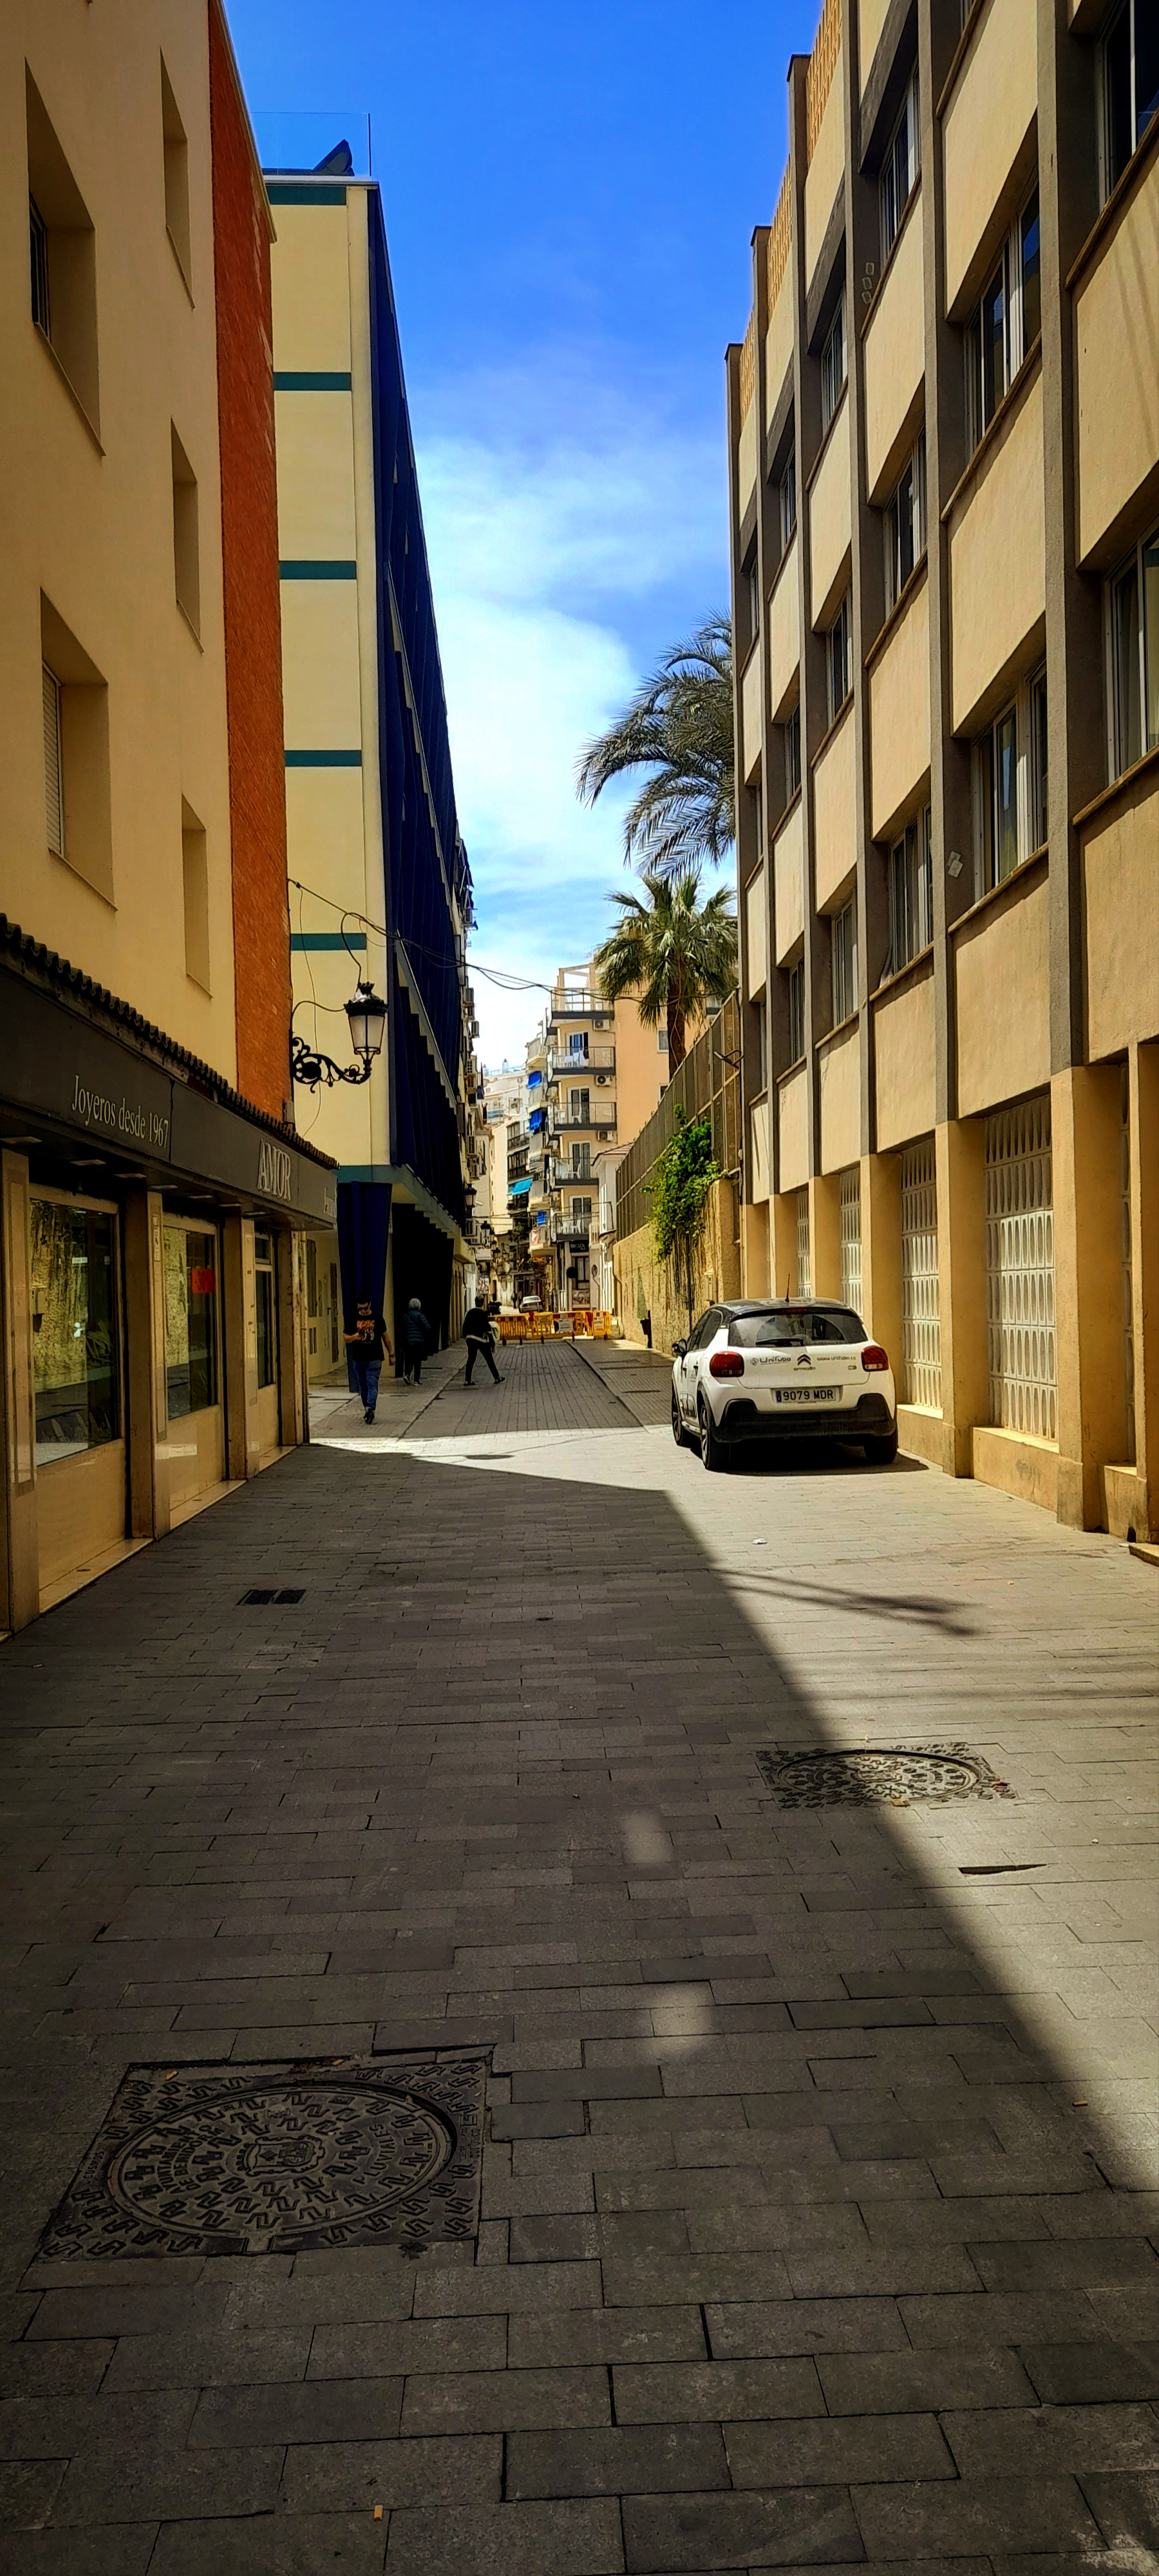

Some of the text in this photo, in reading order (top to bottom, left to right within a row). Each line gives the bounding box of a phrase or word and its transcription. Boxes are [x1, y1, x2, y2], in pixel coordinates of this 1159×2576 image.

[72, 1074, 169, 1149] Joyeros desde 1967
[258, 1139, 291, 1201] AMOR
[783, 1389, 834, 1400] 9079 MDR
[157, 2125, 212, 2194] AYUNTAMIENTO
[174, 2128, 225, 2177] BENIDORM
